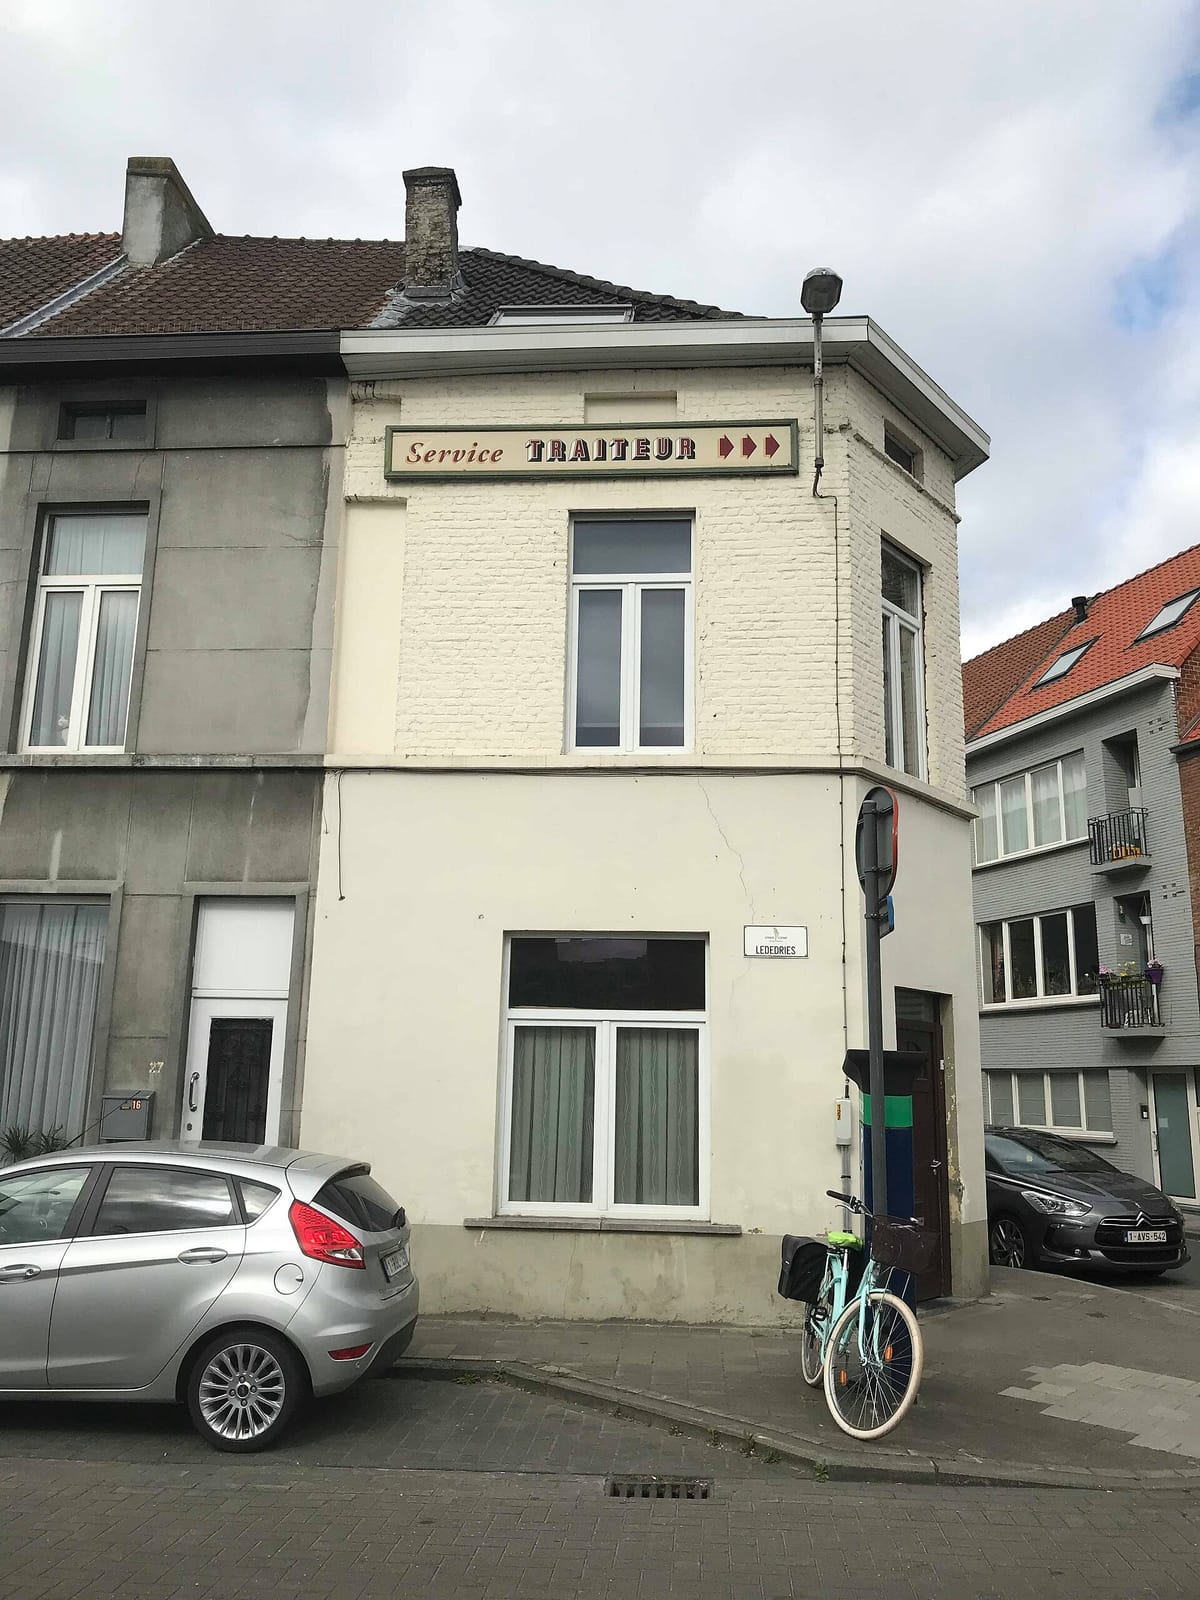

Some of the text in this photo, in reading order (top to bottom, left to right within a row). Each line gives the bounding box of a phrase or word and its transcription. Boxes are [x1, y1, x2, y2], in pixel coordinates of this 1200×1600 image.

[405, 437, 696, 464] Service TRAITEUR
[755, 945, 796, 955] LEDEDRIES
[132, 1100, 141, 1110] 16
